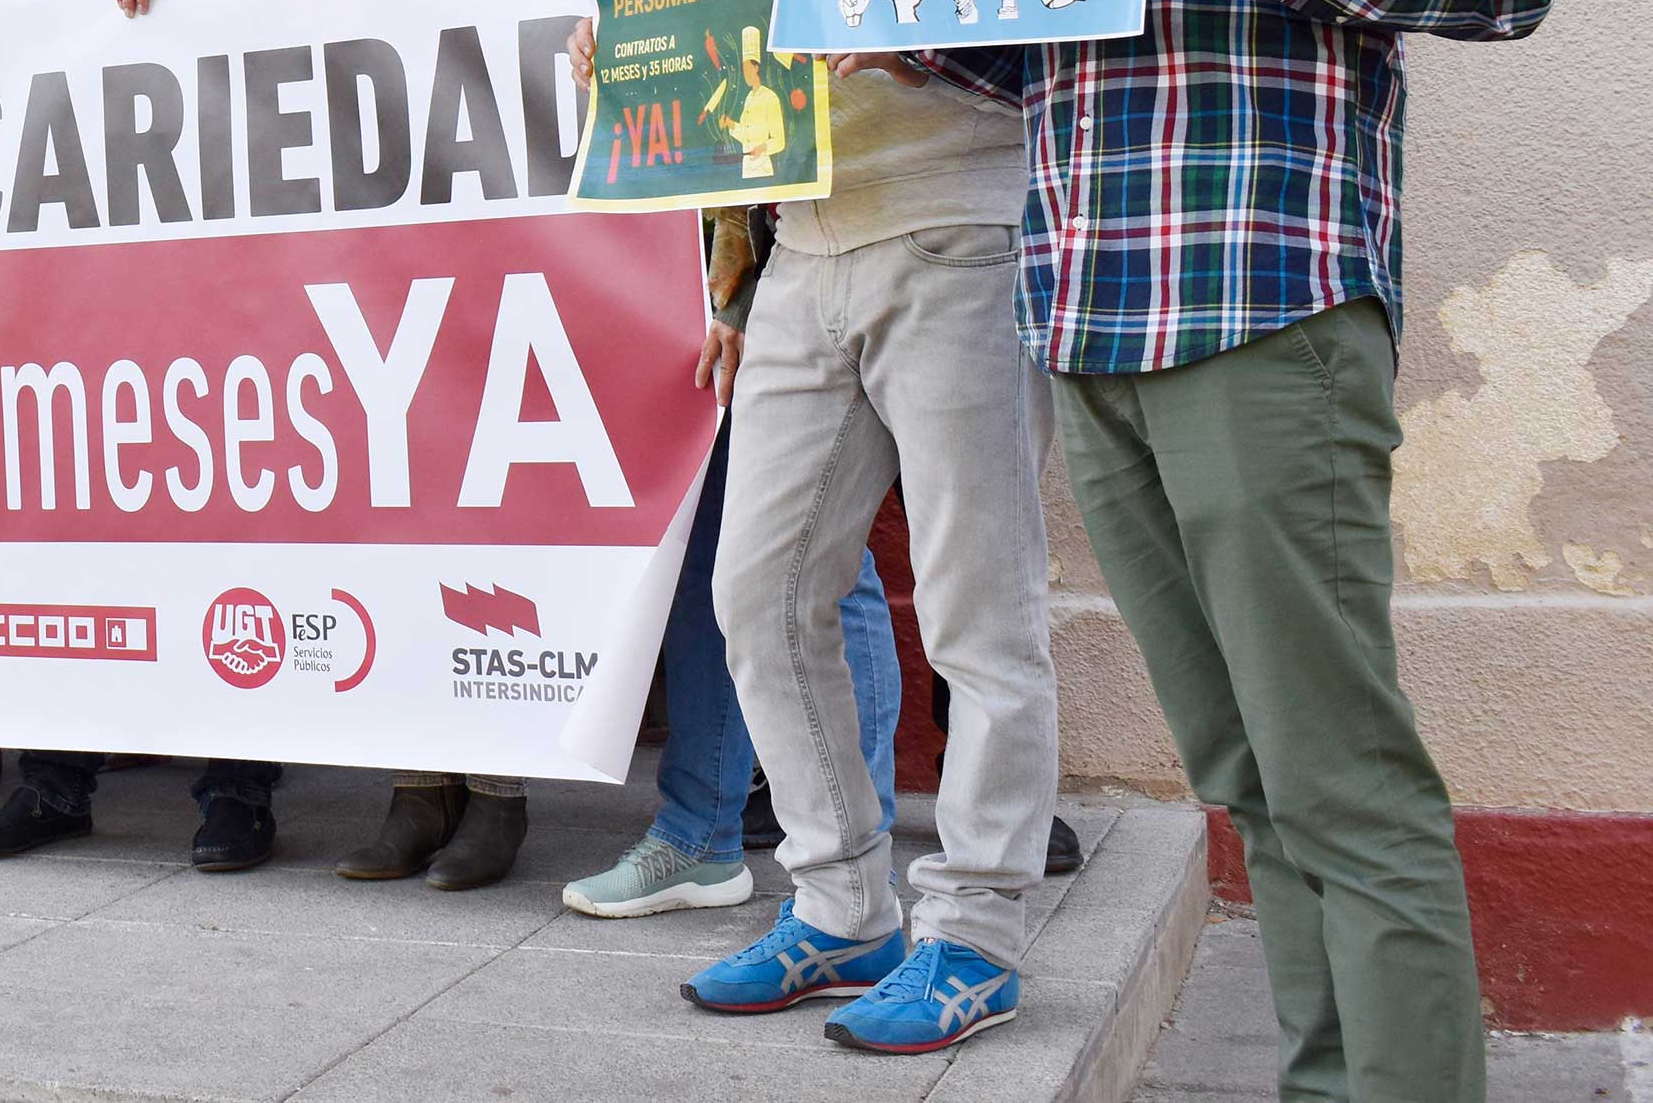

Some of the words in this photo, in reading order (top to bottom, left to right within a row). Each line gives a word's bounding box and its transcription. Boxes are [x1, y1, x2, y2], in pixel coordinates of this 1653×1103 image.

[614, 37, 667, 58] CONTRATOS
[667, 34, 676, 50] A
[600, 69, 609, 84] 12
[611, 64, 640, 82] MESES
[641, 66, 648, 81] y
[649, 61, 661, 76] 35
[662, 55, 693, 73] HORAS
[607, 100, 683, 184] ¡YA!
[214, 603, 276, 642] UGT
[293, 645, 333, 660] Servicios
[293, 658, 331, 673] Públicos
[452, 648, 599, 679] STAS-CLM
